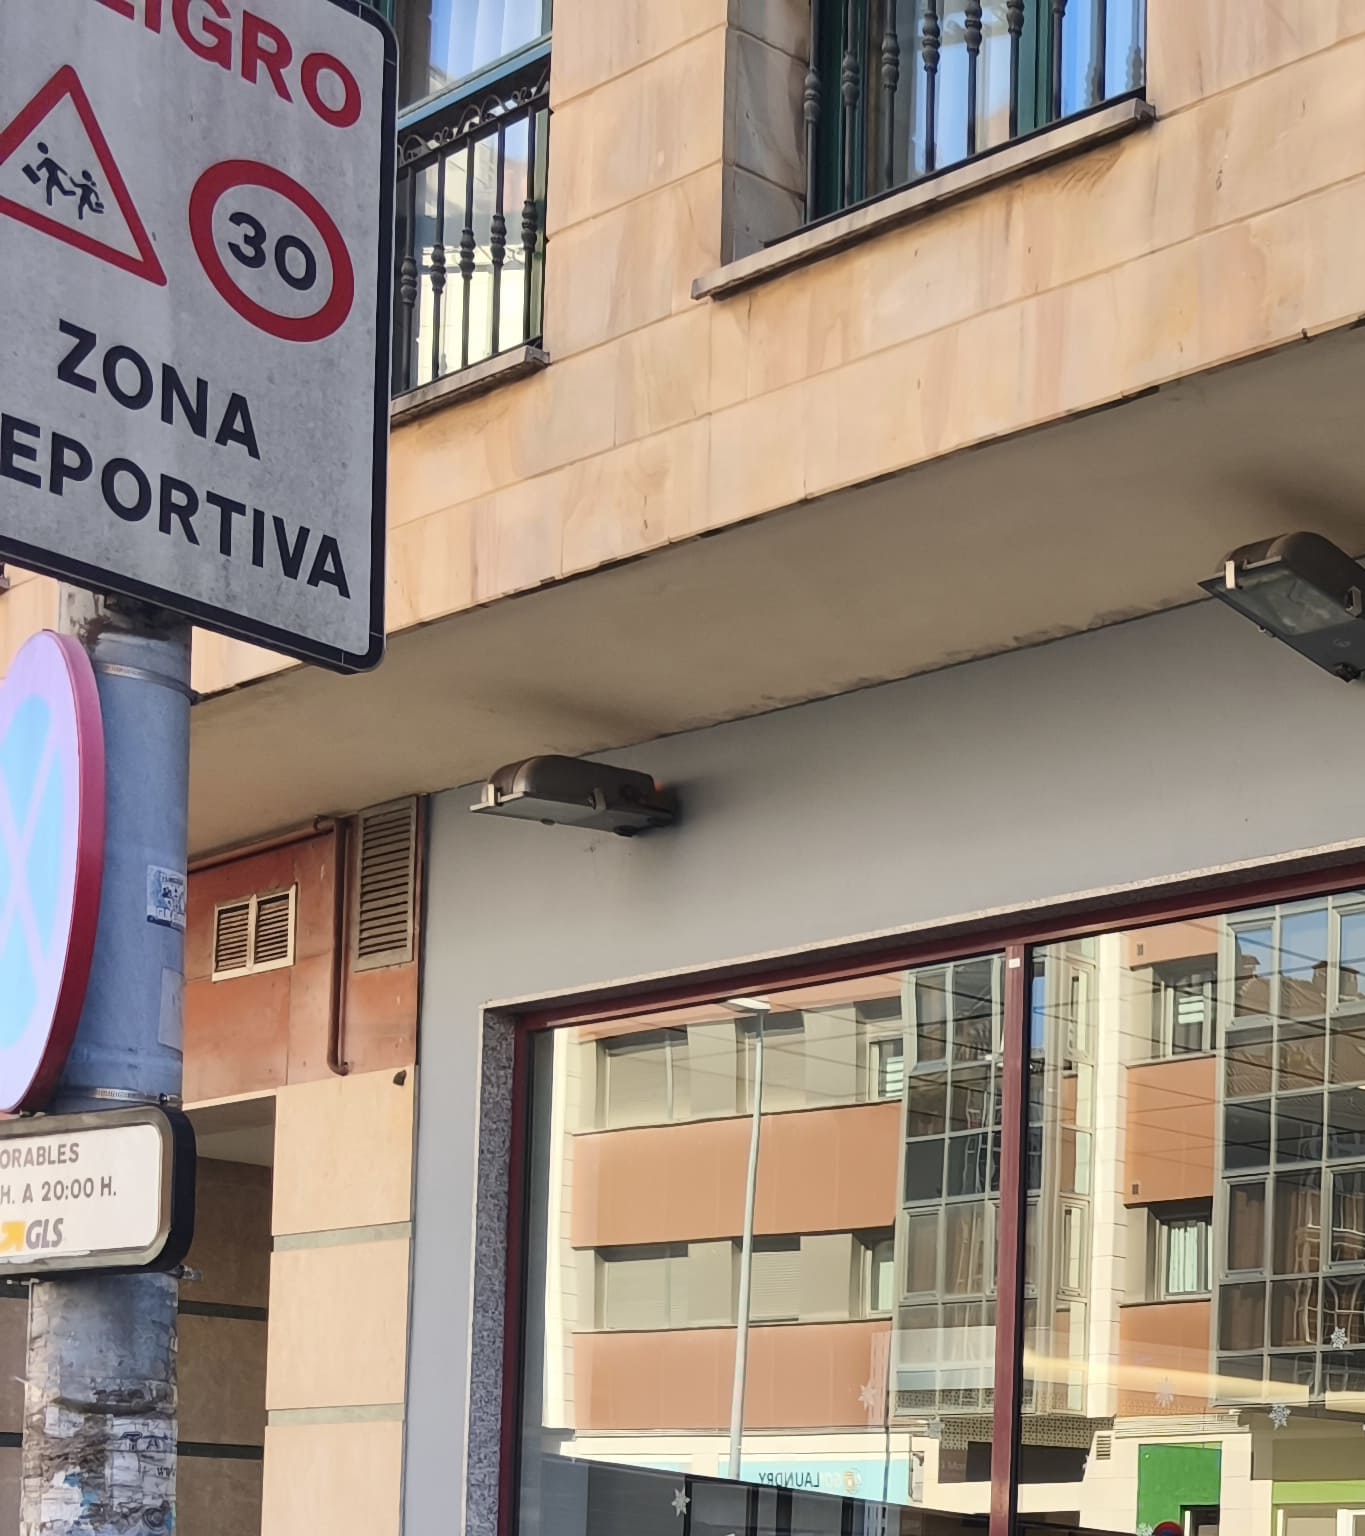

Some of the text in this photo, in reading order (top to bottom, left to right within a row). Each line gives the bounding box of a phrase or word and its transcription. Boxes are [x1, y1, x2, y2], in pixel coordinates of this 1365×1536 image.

[95, 0, 361, 128] GRO
[227, 211, 317, 290] 30
[57, 318, 261, 460] ZONA
[0, 413, 351, 600] EPORTIVA
[22, 1183, 34, 1204] A
[41, 1177, 95, 1202] 20:00
[100, 1175, 117, 1198] H.
[26, 1217, 65, 1250] GLS
